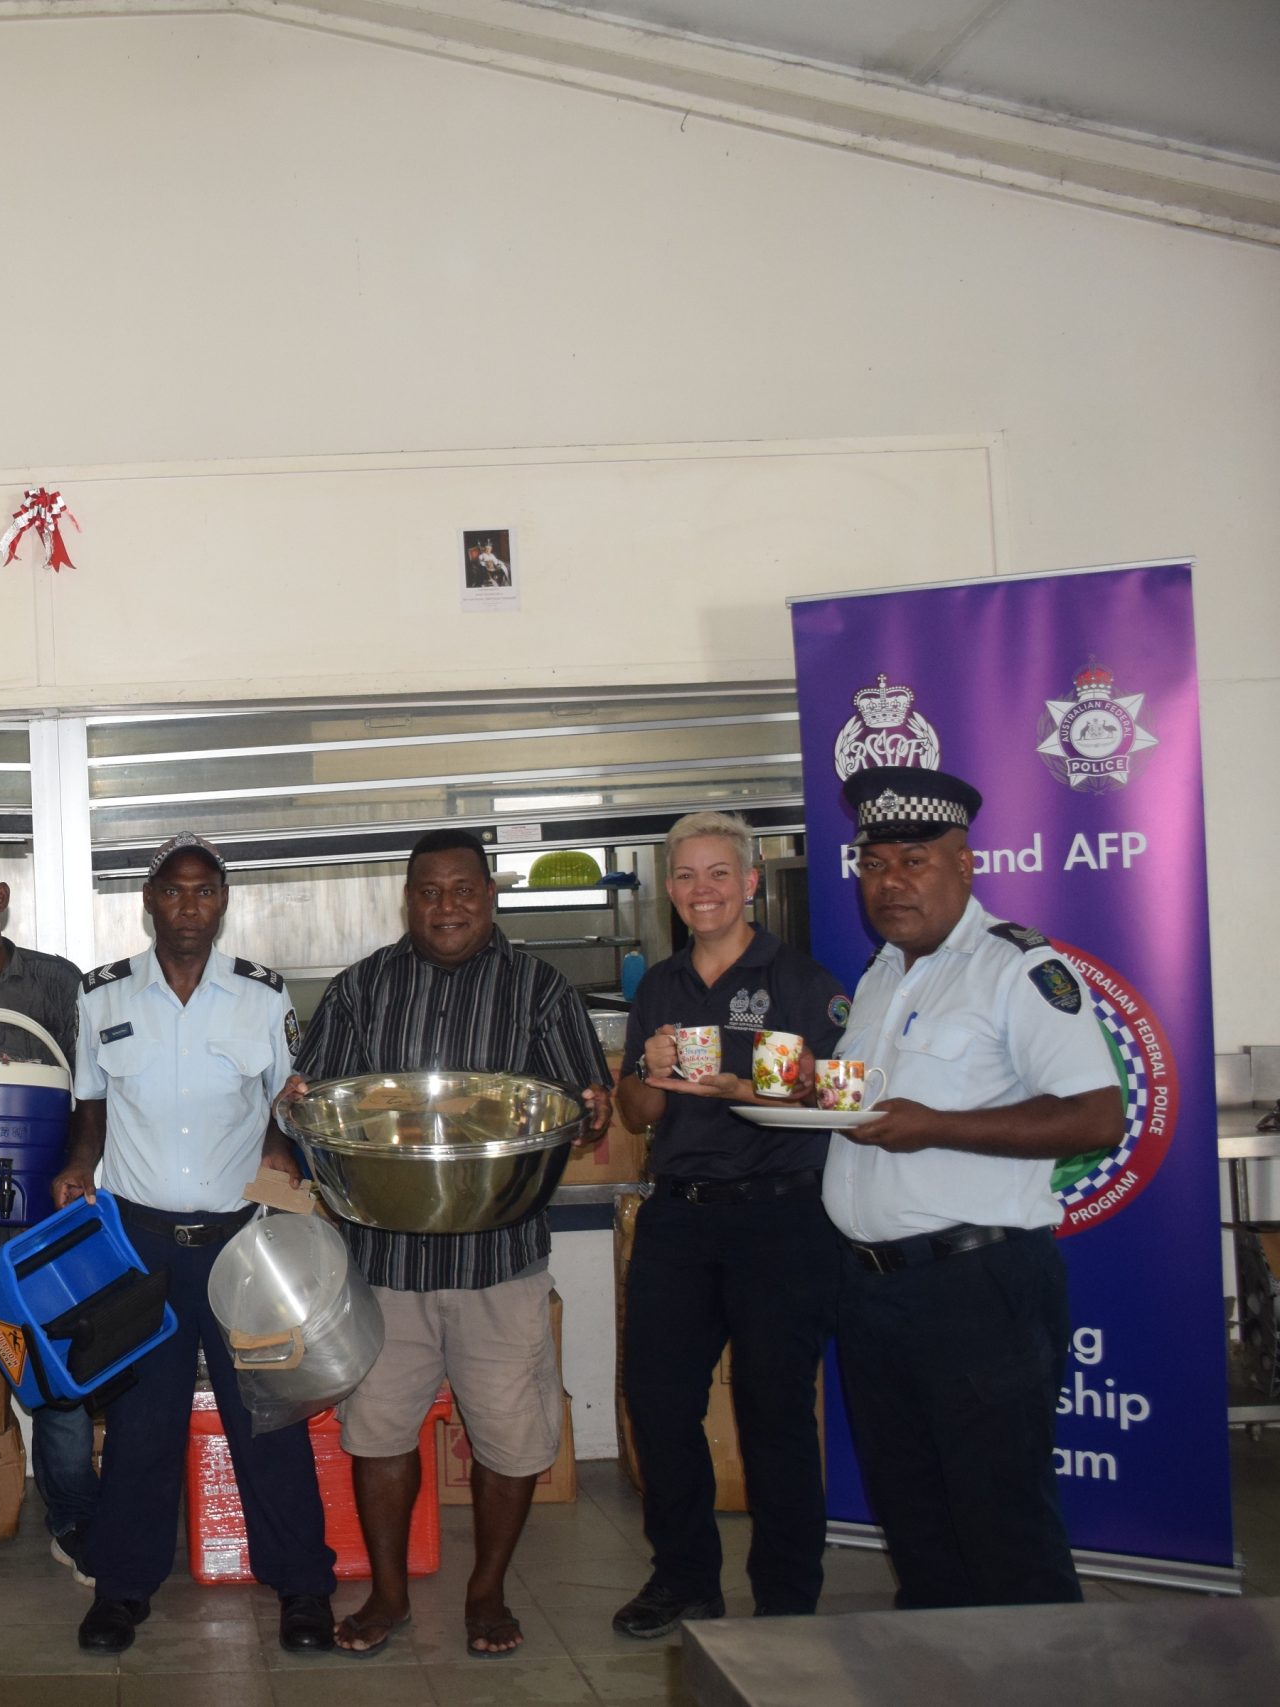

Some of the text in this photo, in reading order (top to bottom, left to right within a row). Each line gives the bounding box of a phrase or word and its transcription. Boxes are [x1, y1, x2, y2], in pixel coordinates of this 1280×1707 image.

[1061, 701, 1133, 743] AUSTRALIAN FEDERAL
[1071, 759, 1125, 773] POLICE
[970, 831, 1148, 874] and AFP
[1133, 1017, 1167, 1079] FEDERAL
[1148, 1086, 1169, 1136] POLICE
[1069, 1170, 1139, 1225] PROGRAM
